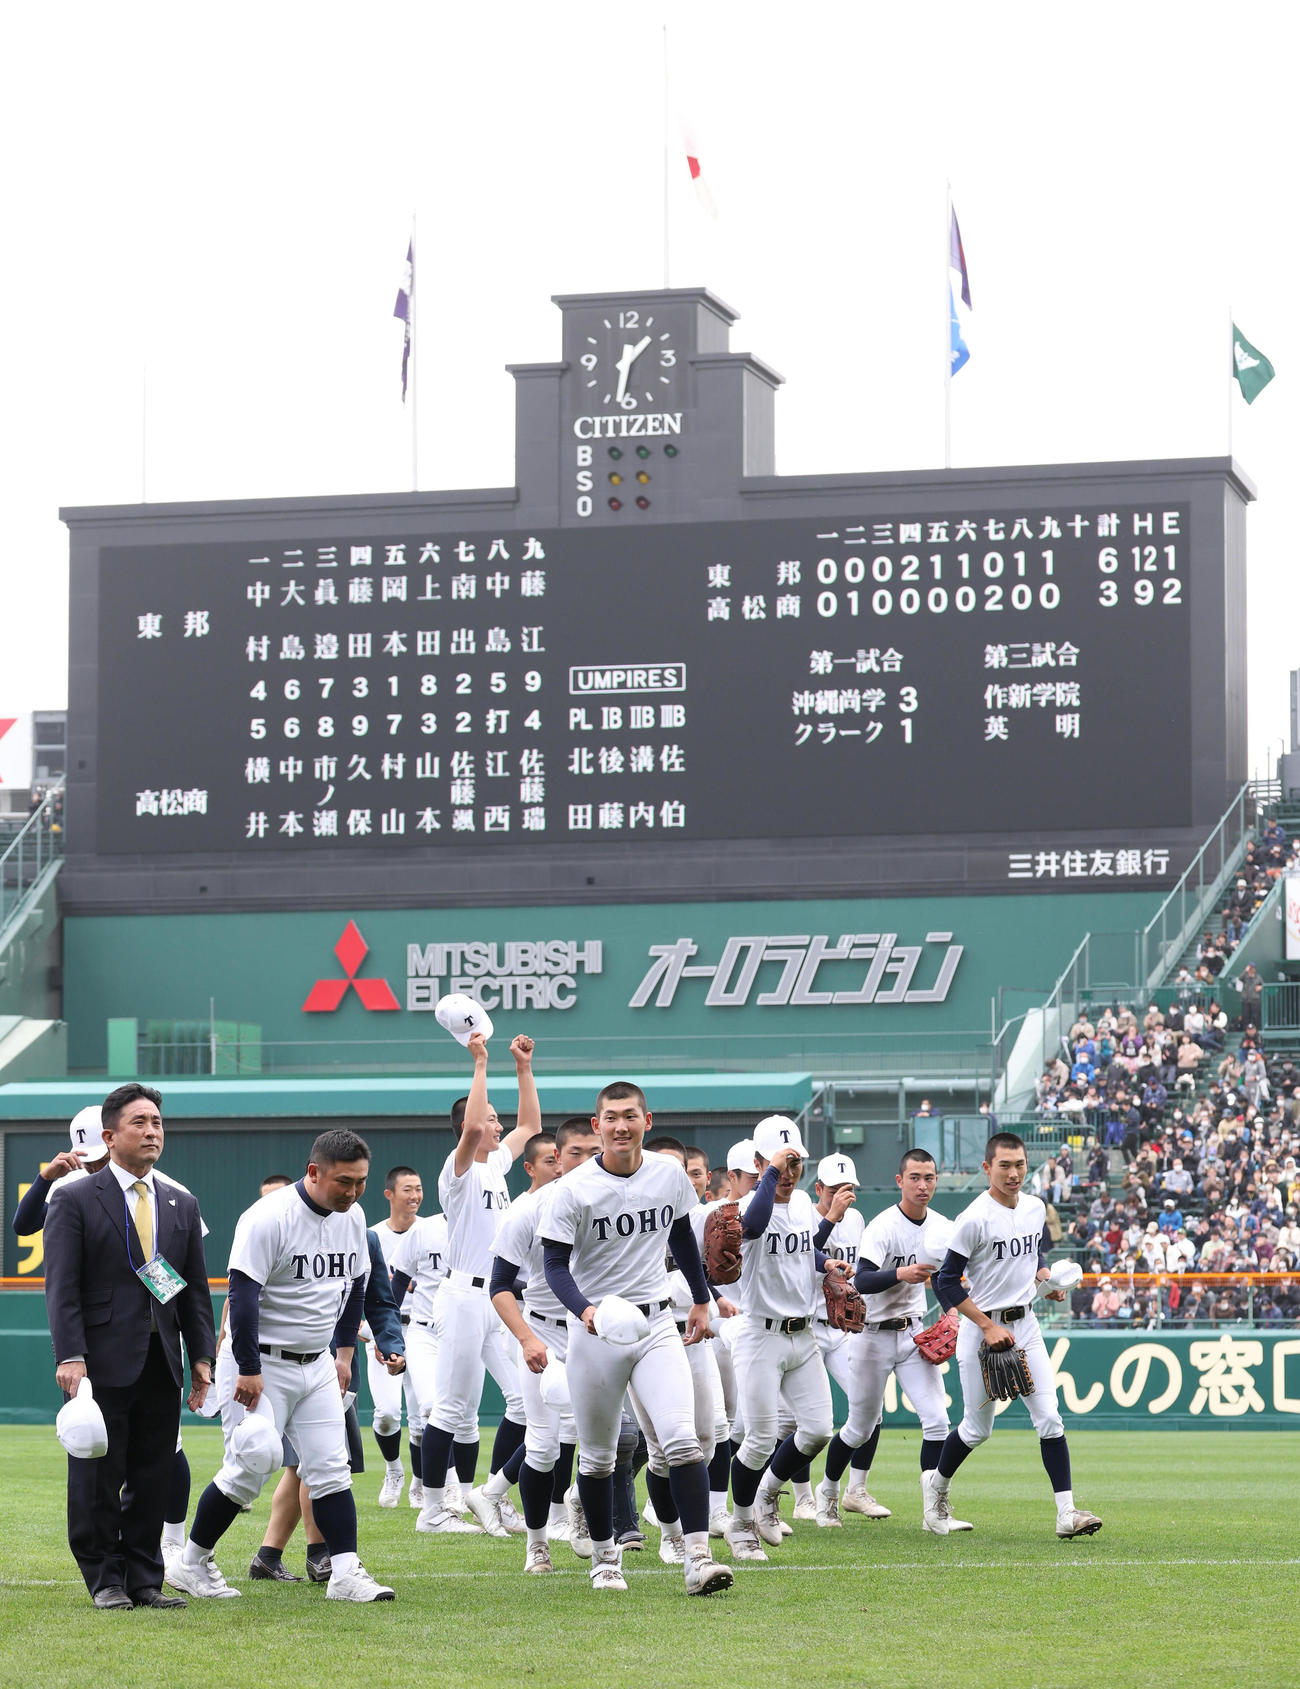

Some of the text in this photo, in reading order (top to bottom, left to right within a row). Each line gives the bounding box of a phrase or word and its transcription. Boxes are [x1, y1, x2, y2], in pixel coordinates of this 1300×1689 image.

[619, 311, 640, 329] 12
[580, 354, 598, 371] 9
[660, 350, 676, 367] 3
[620, 393, 638, 410] 6
[573, 412, 683, 439] CITIZEN
[576, 444, 593, 467] B
[576, 471, 593, 491] S
[1099, 547, 1119, 573] 6
[1099, 579, 1119, 606] 3
[137, 611, 209, 639] 東邦
[809, 648, 904, 674] 第一試合
[984, 642, 1080, 668] 第三試合
[250, 671, 542, 700] 4 6 7 3 1 8 2 5 9
[577, 667, 679, 690] UMPIRES
[899, 687, 918, 712] 3
[984, 682, 1080, 709] 作新学院
[251, 709, 541, 739] 5 6 8 9 7 3 2 打 4
[795, 718, 913, 745] クラーク 1
[1007, 848, 1170, 879] 三井住友銀行
[407, 939, 602, 977] MITSUBISHI
[628, 931, 964, 1008] オーロラビジョン
[463, 1014, 475, 1028] T
[76, 1128, 87, 1144] T
[779, 1129, 791, 1144] T
[837, 1162, 847, 1174] T
[591, 1203, 674, 1241] TOHO
